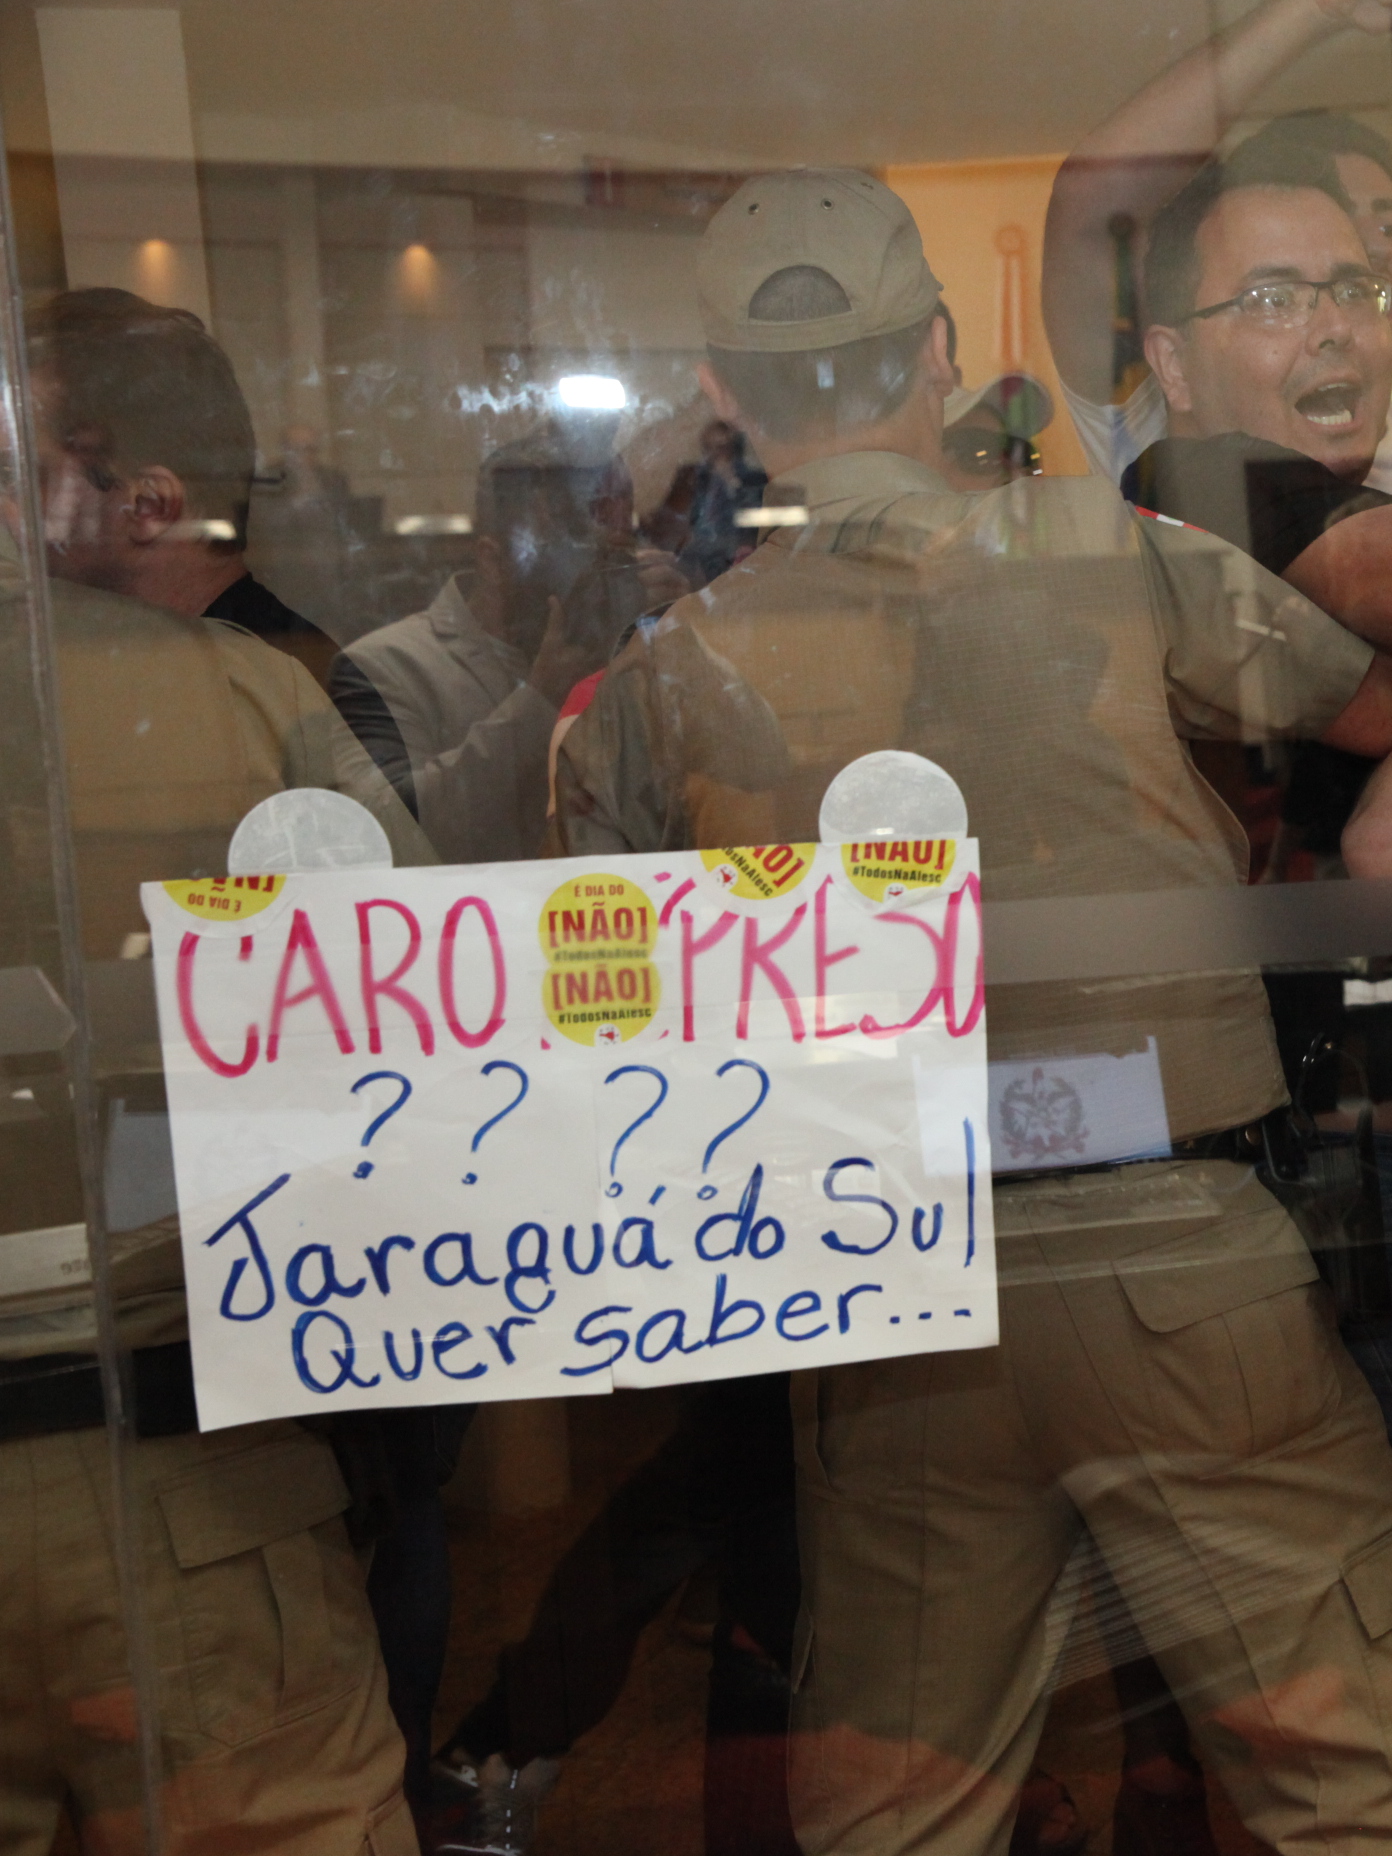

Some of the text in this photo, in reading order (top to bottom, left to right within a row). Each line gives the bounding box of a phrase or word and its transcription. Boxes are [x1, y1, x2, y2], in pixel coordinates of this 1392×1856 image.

[721, 847, 774, 897] osNaAlesc
[852, 865, 942, 884] #TodosNaAlesc
[187, 892, 206, 907] DO
[209, 895, 231, 910] DIA
[574, 884, 625, 898] É DIA DO
[548, 900, 649, 949] [NÃO]
[176, 895, 507, 1078] CARO
[558, 1008, 652, 1025] #TodosNaAlesc
[206, 1173, 672, 1322] Jaraguá
[695, 1163, 786, 1262] do
[292, 1311, 536, 1393] Quer
